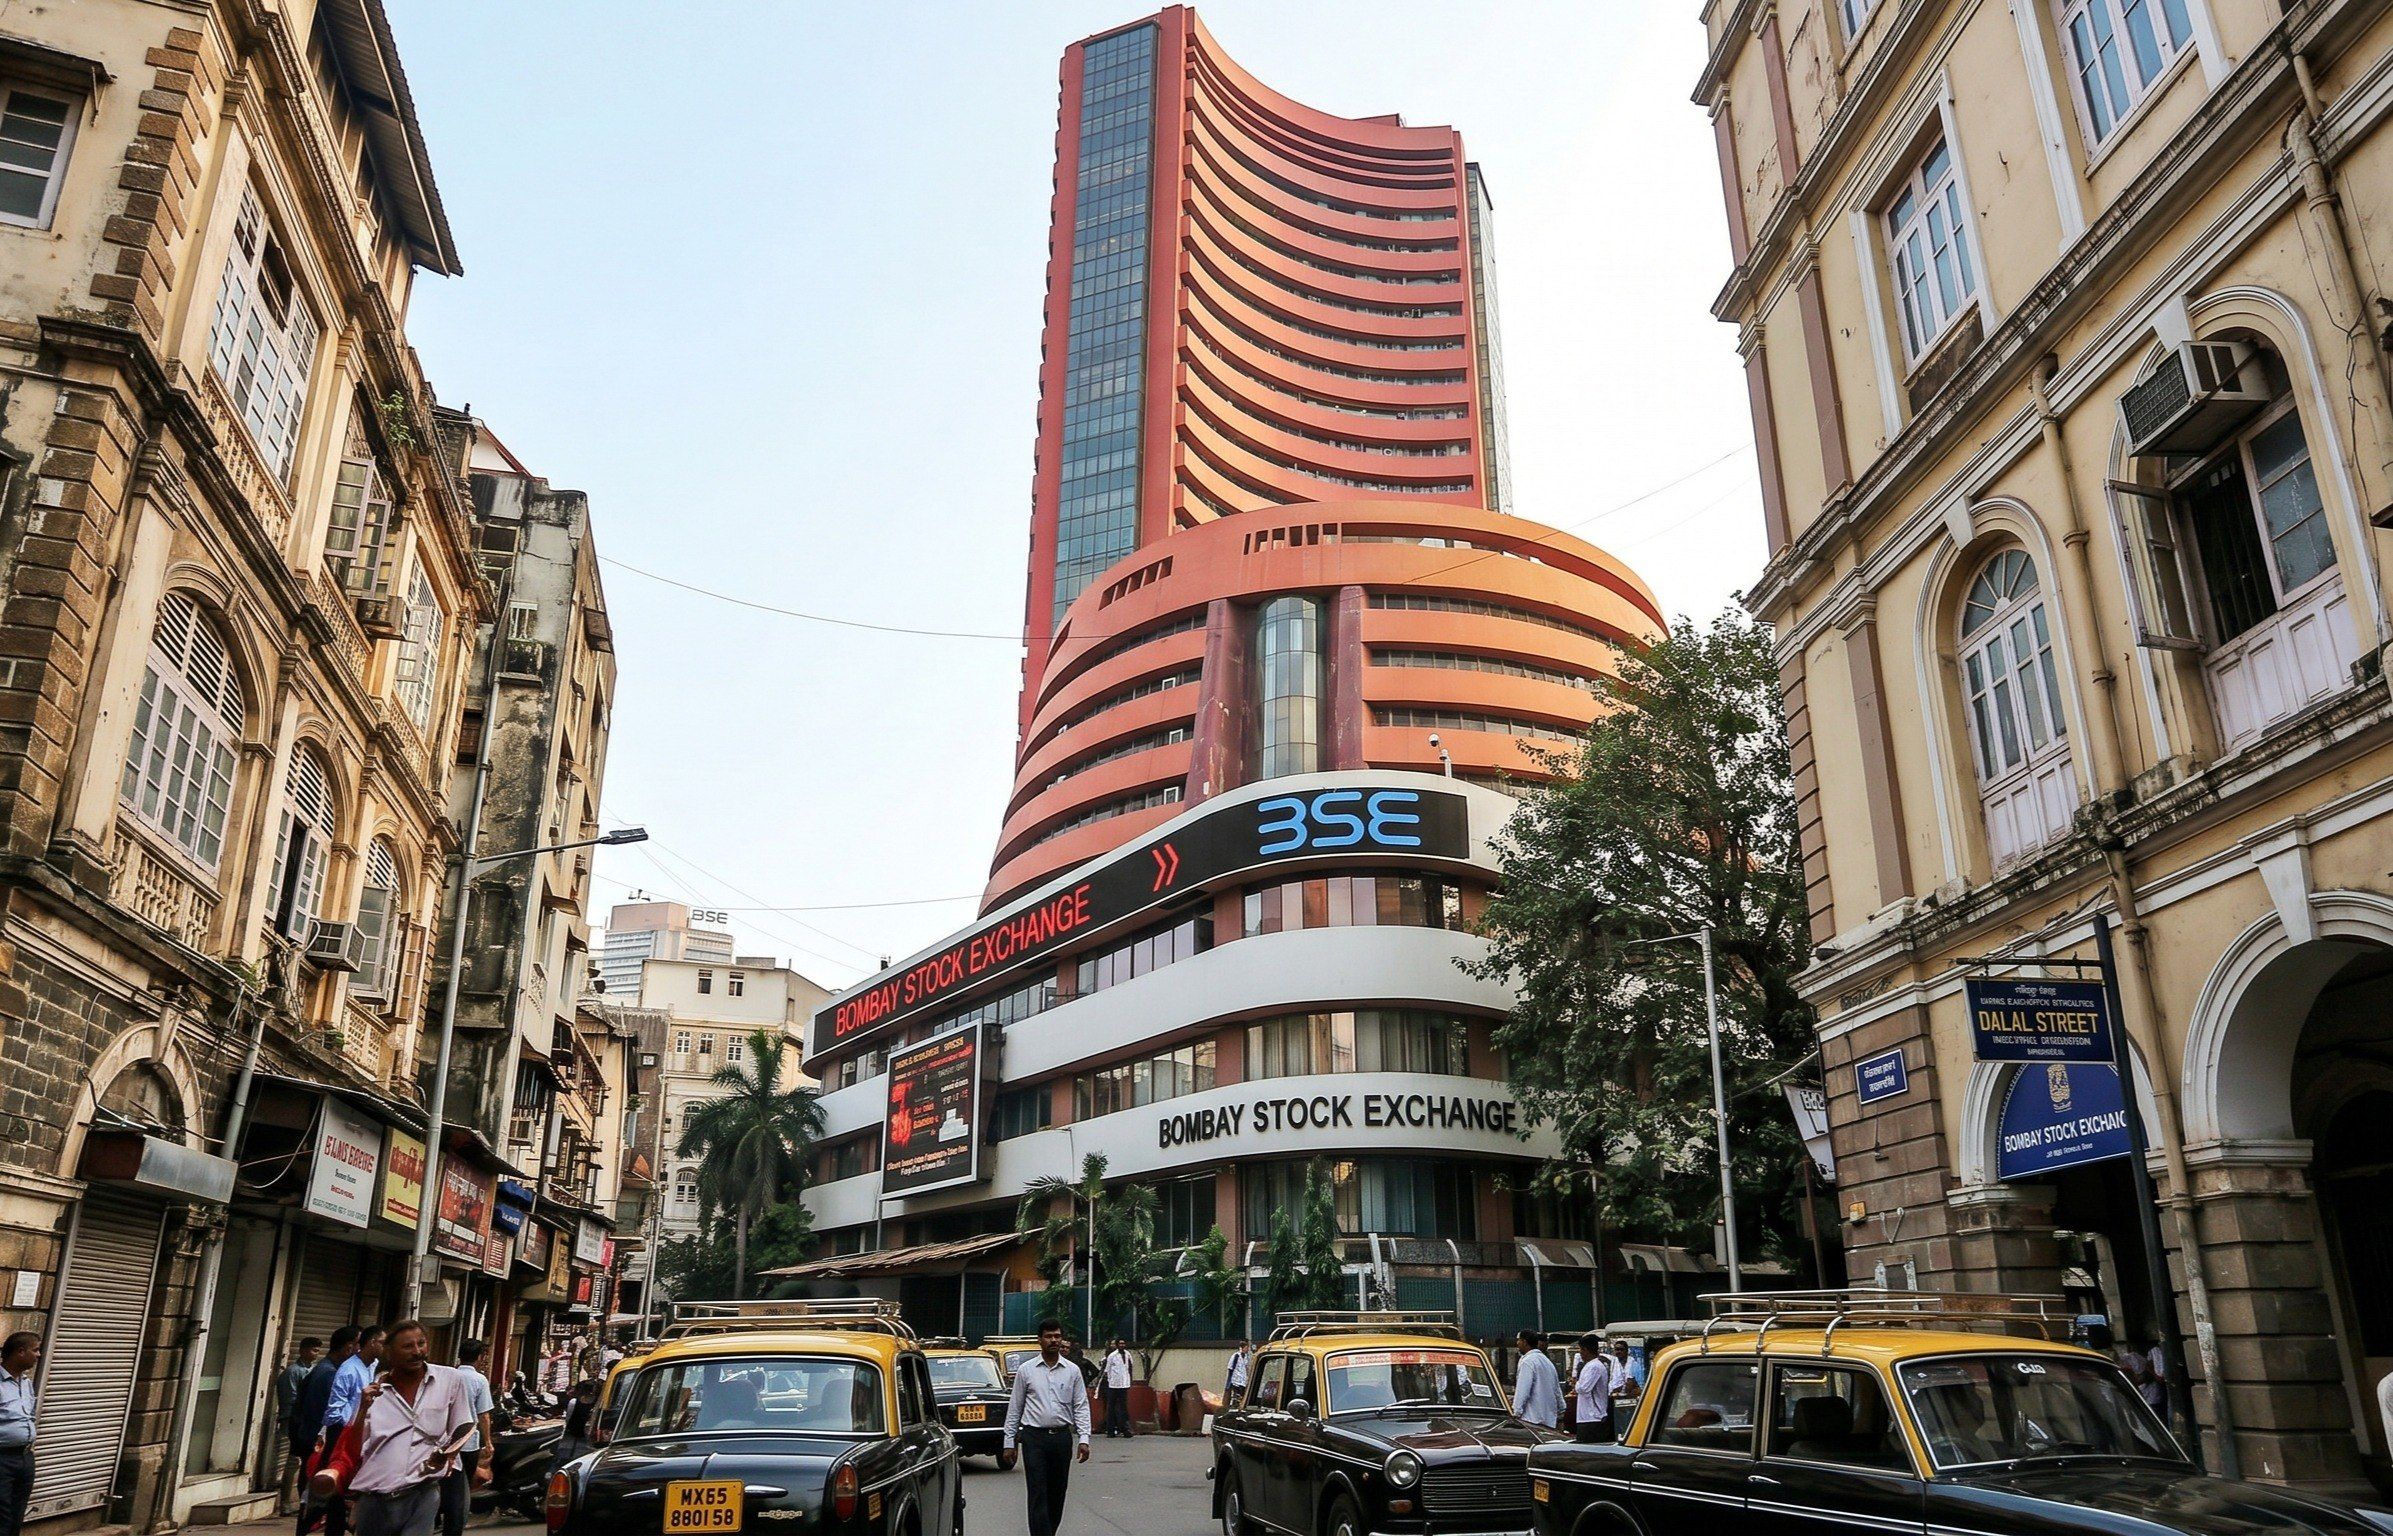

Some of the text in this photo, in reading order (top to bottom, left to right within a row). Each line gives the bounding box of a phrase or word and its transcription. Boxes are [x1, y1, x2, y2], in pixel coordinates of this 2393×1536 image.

[1258, 791, 1421, 855] BSE
[691, 909, 728, 924] BSE
[835, 884, 1091, 1037] BOMBAY STOCK EXCHANGE
[1978, 1010, 2099, 1033] DALAL STREET
[1158, 1094, 1518, 1150] BOMBAY STOCK EXCHANGE
[2004, 1129, 2042, 1153] BOMBAY
[2043, 1121, 2079, 1144] STOCK
